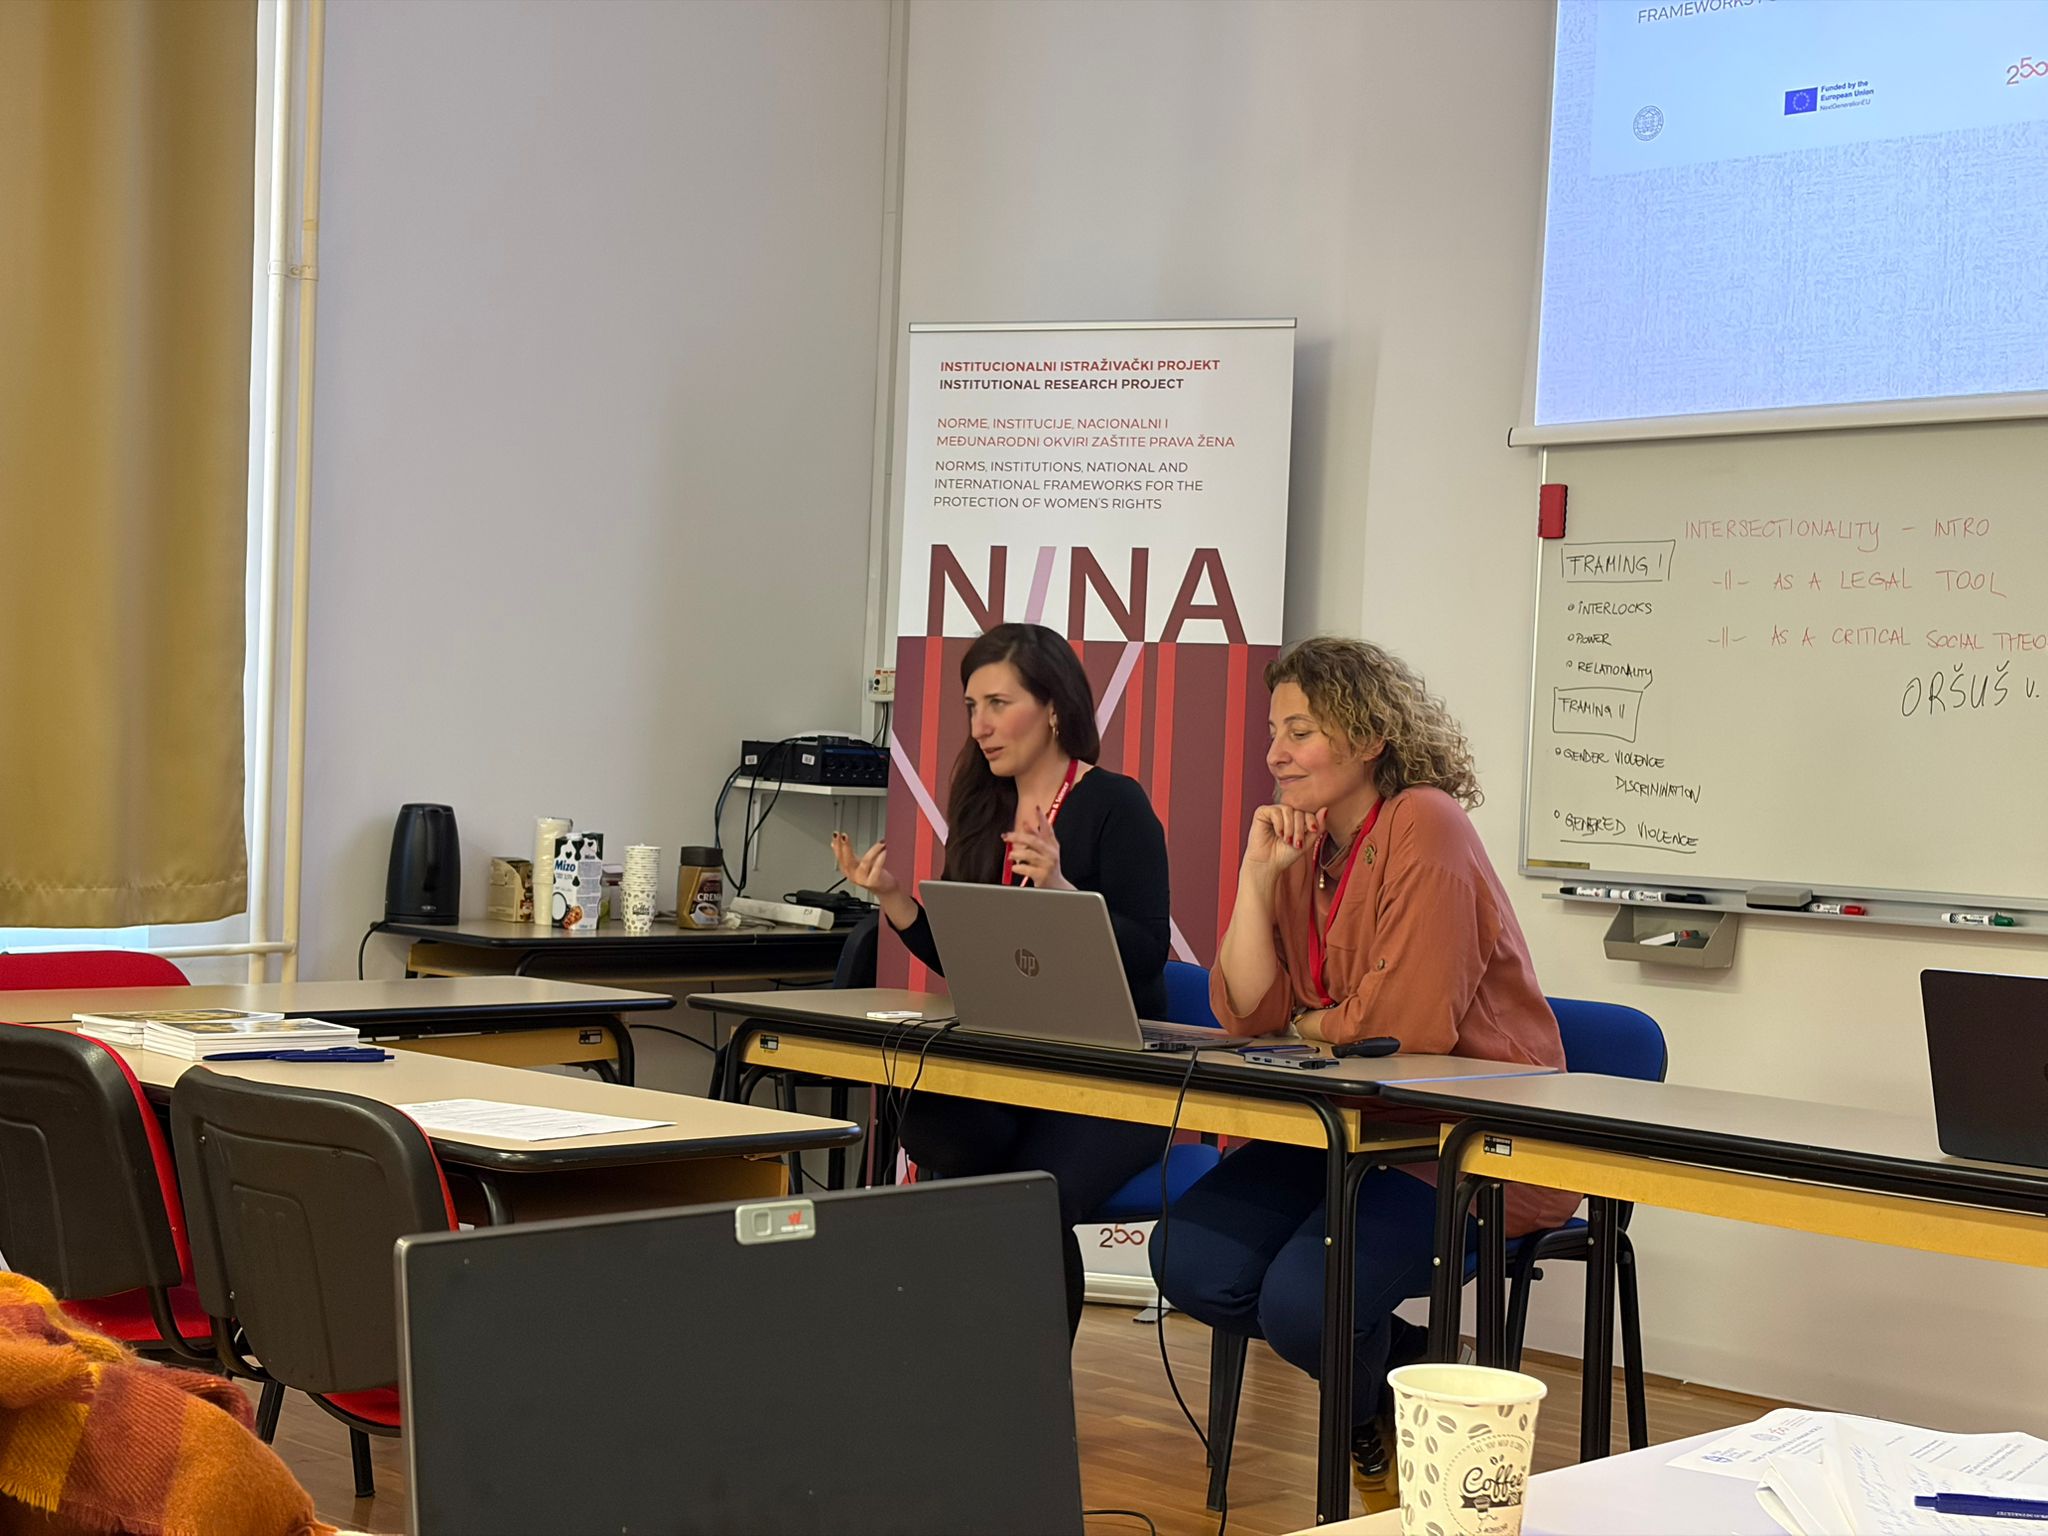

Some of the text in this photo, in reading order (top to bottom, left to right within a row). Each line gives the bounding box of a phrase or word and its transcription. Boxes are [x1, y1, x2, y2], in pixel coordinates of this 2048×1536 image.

[1821, 83, 1846, 92] Funded
[1820, 88, 1874, 101] European Union
[941, 358, 1220, 371] INSTITUCIONALNI ISTRAŽIVAČKI PROJEKT
[940, 379, 1183, 390] INSTITUTIONAL RESEARCH PROJECT
[938, 418, 1168, 430] NORME, INSTITUCIJE, NACIONALNI I
[937, 434, 1235, 447] MEĐUNARODNI OKVIRI ZAŠTITE PRAVA ŽENA
[935, 461, 1188, 473] NORMS, INSTITUTIONS, NATIONAL AND
[934, 479, 1203, 491] INTERNATIONAL FRAMEWORKS FOR THE
[934, 497, 1018, 508] PROTECTION
[1023, 498, 1040, 508] OF
[1112, 499, 1162, 510] RIGHTS
[1685, 518, 1880, 552] INTERSECTIONALITY
[1935, 517, 1990, 538] INTRO
[1566, 554, 1649, 576] FRAMING
[1774, 572, 1794, 590] AS
[1809, 572, 1821, 590] A
[1841, 567, 1912, 591] LEGAL
[1936, 570, 2007, 598] TOOL
[1771, 624, 1789, 646] AS
[1802, 627, 1815, 647] A
[1832, 626, 1911, 646] CRITICAL
[1926, 629, 1984, 651] SOCIAL
[1992, 632, 2048, 652] THEO
[1902, 660, 2010, 717] ORŠUŠ
[1563, 748, 1665, 768] GENDER VIOLENCE
[1638, 821, 1699, 847] VIOLENCE
[555, 859, 576, 872] Mizo
[1463, 1464, 1524, 1499] Coffee
